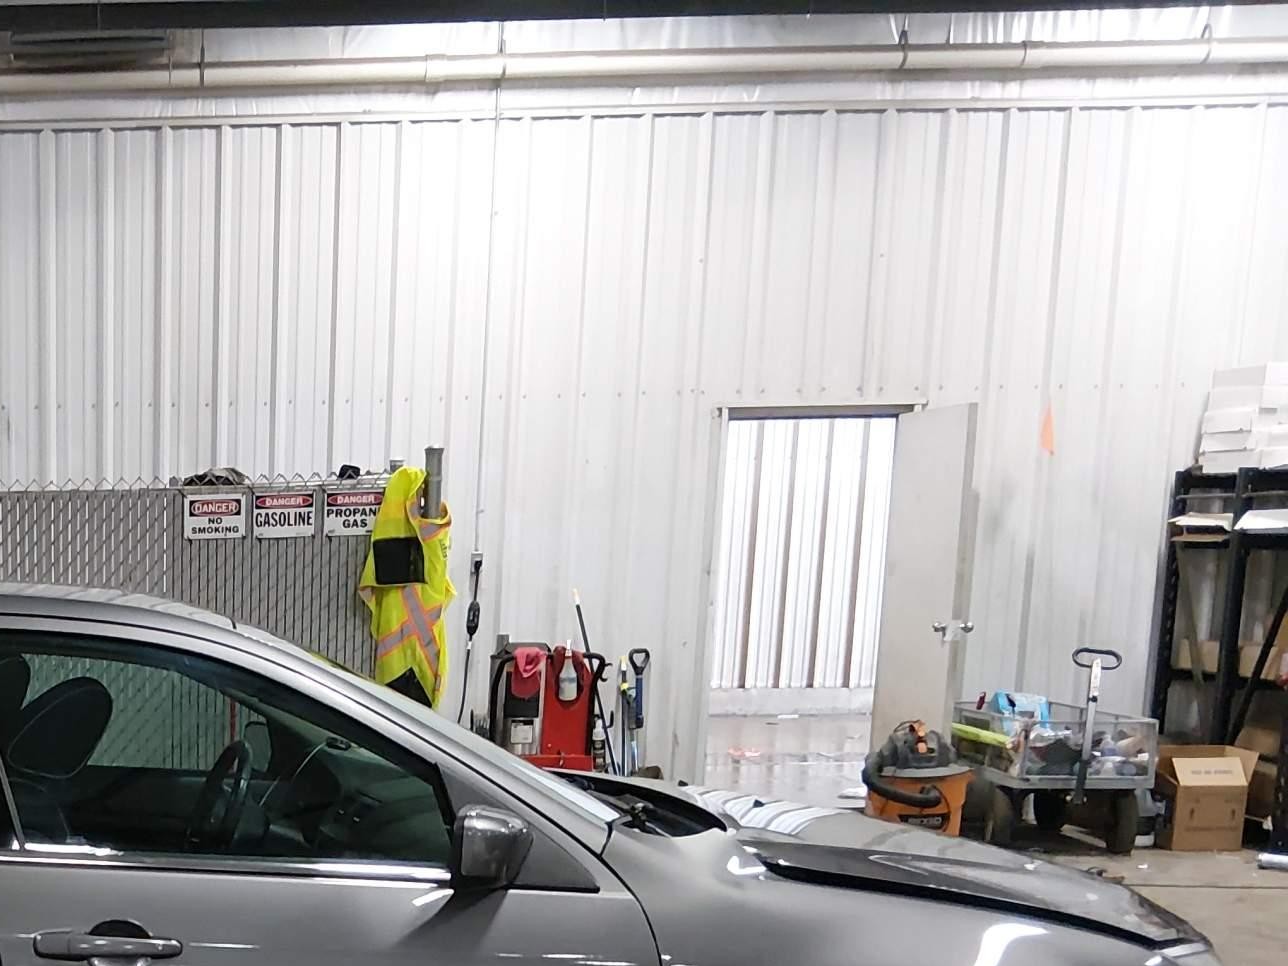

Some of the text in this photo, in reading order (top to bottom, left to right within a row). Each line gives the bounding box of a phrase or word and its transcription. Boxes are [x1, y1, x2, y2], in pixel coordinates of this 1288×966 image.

[265, 497, 303, 505] DANGER
[337, 495, 375, 504] DANGER
[195, 503, 236, 512] DANGER
[208, 517, 223, 525] NO
[255, 511, 313, 527] GASOLINE
[342, 519, 368, 528] GAS
[192, 526, 239, 534] SMOKING
